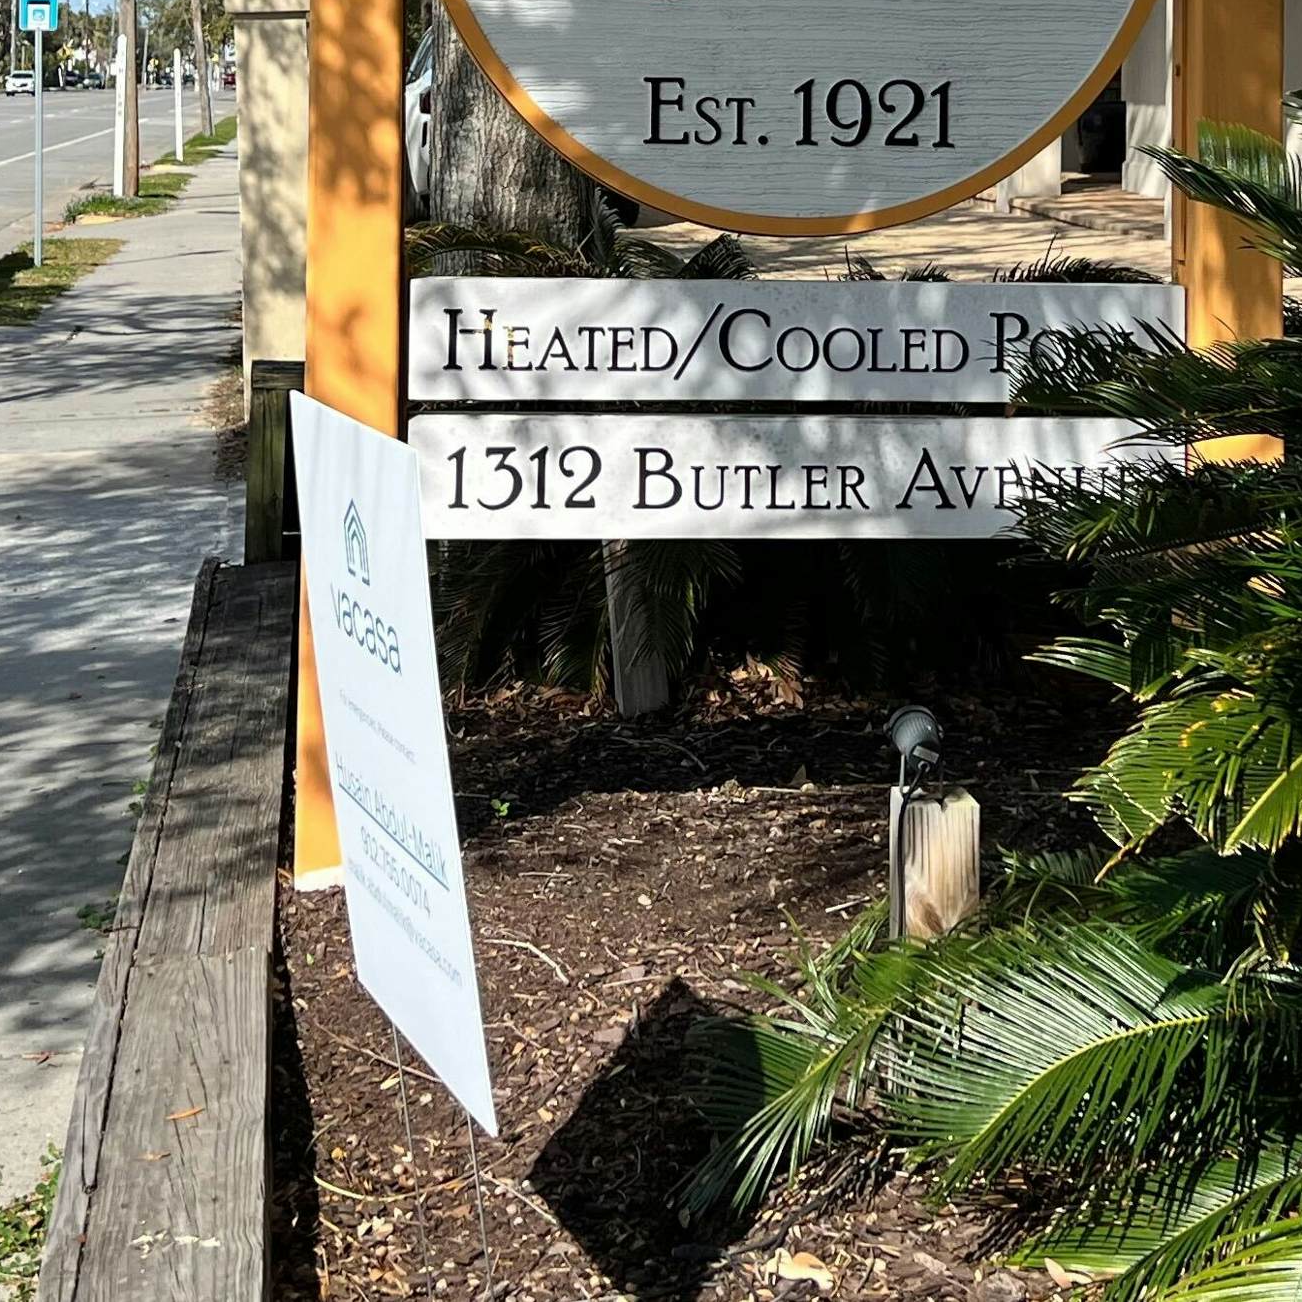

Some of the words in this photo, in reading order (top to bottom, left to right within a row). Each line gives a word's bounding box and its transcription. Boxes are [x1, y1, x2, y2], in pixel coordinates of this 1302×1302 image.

[642, 76, 769, 148] EST.
[793, 78, 955, 150] 1921
[442, 302, 970, 380] HEATED/COOLED
[447, 445, 602, 510] 1312
[633, 446, 870, 510] BUTLER
[330, 582, 403, 677] vacasa
